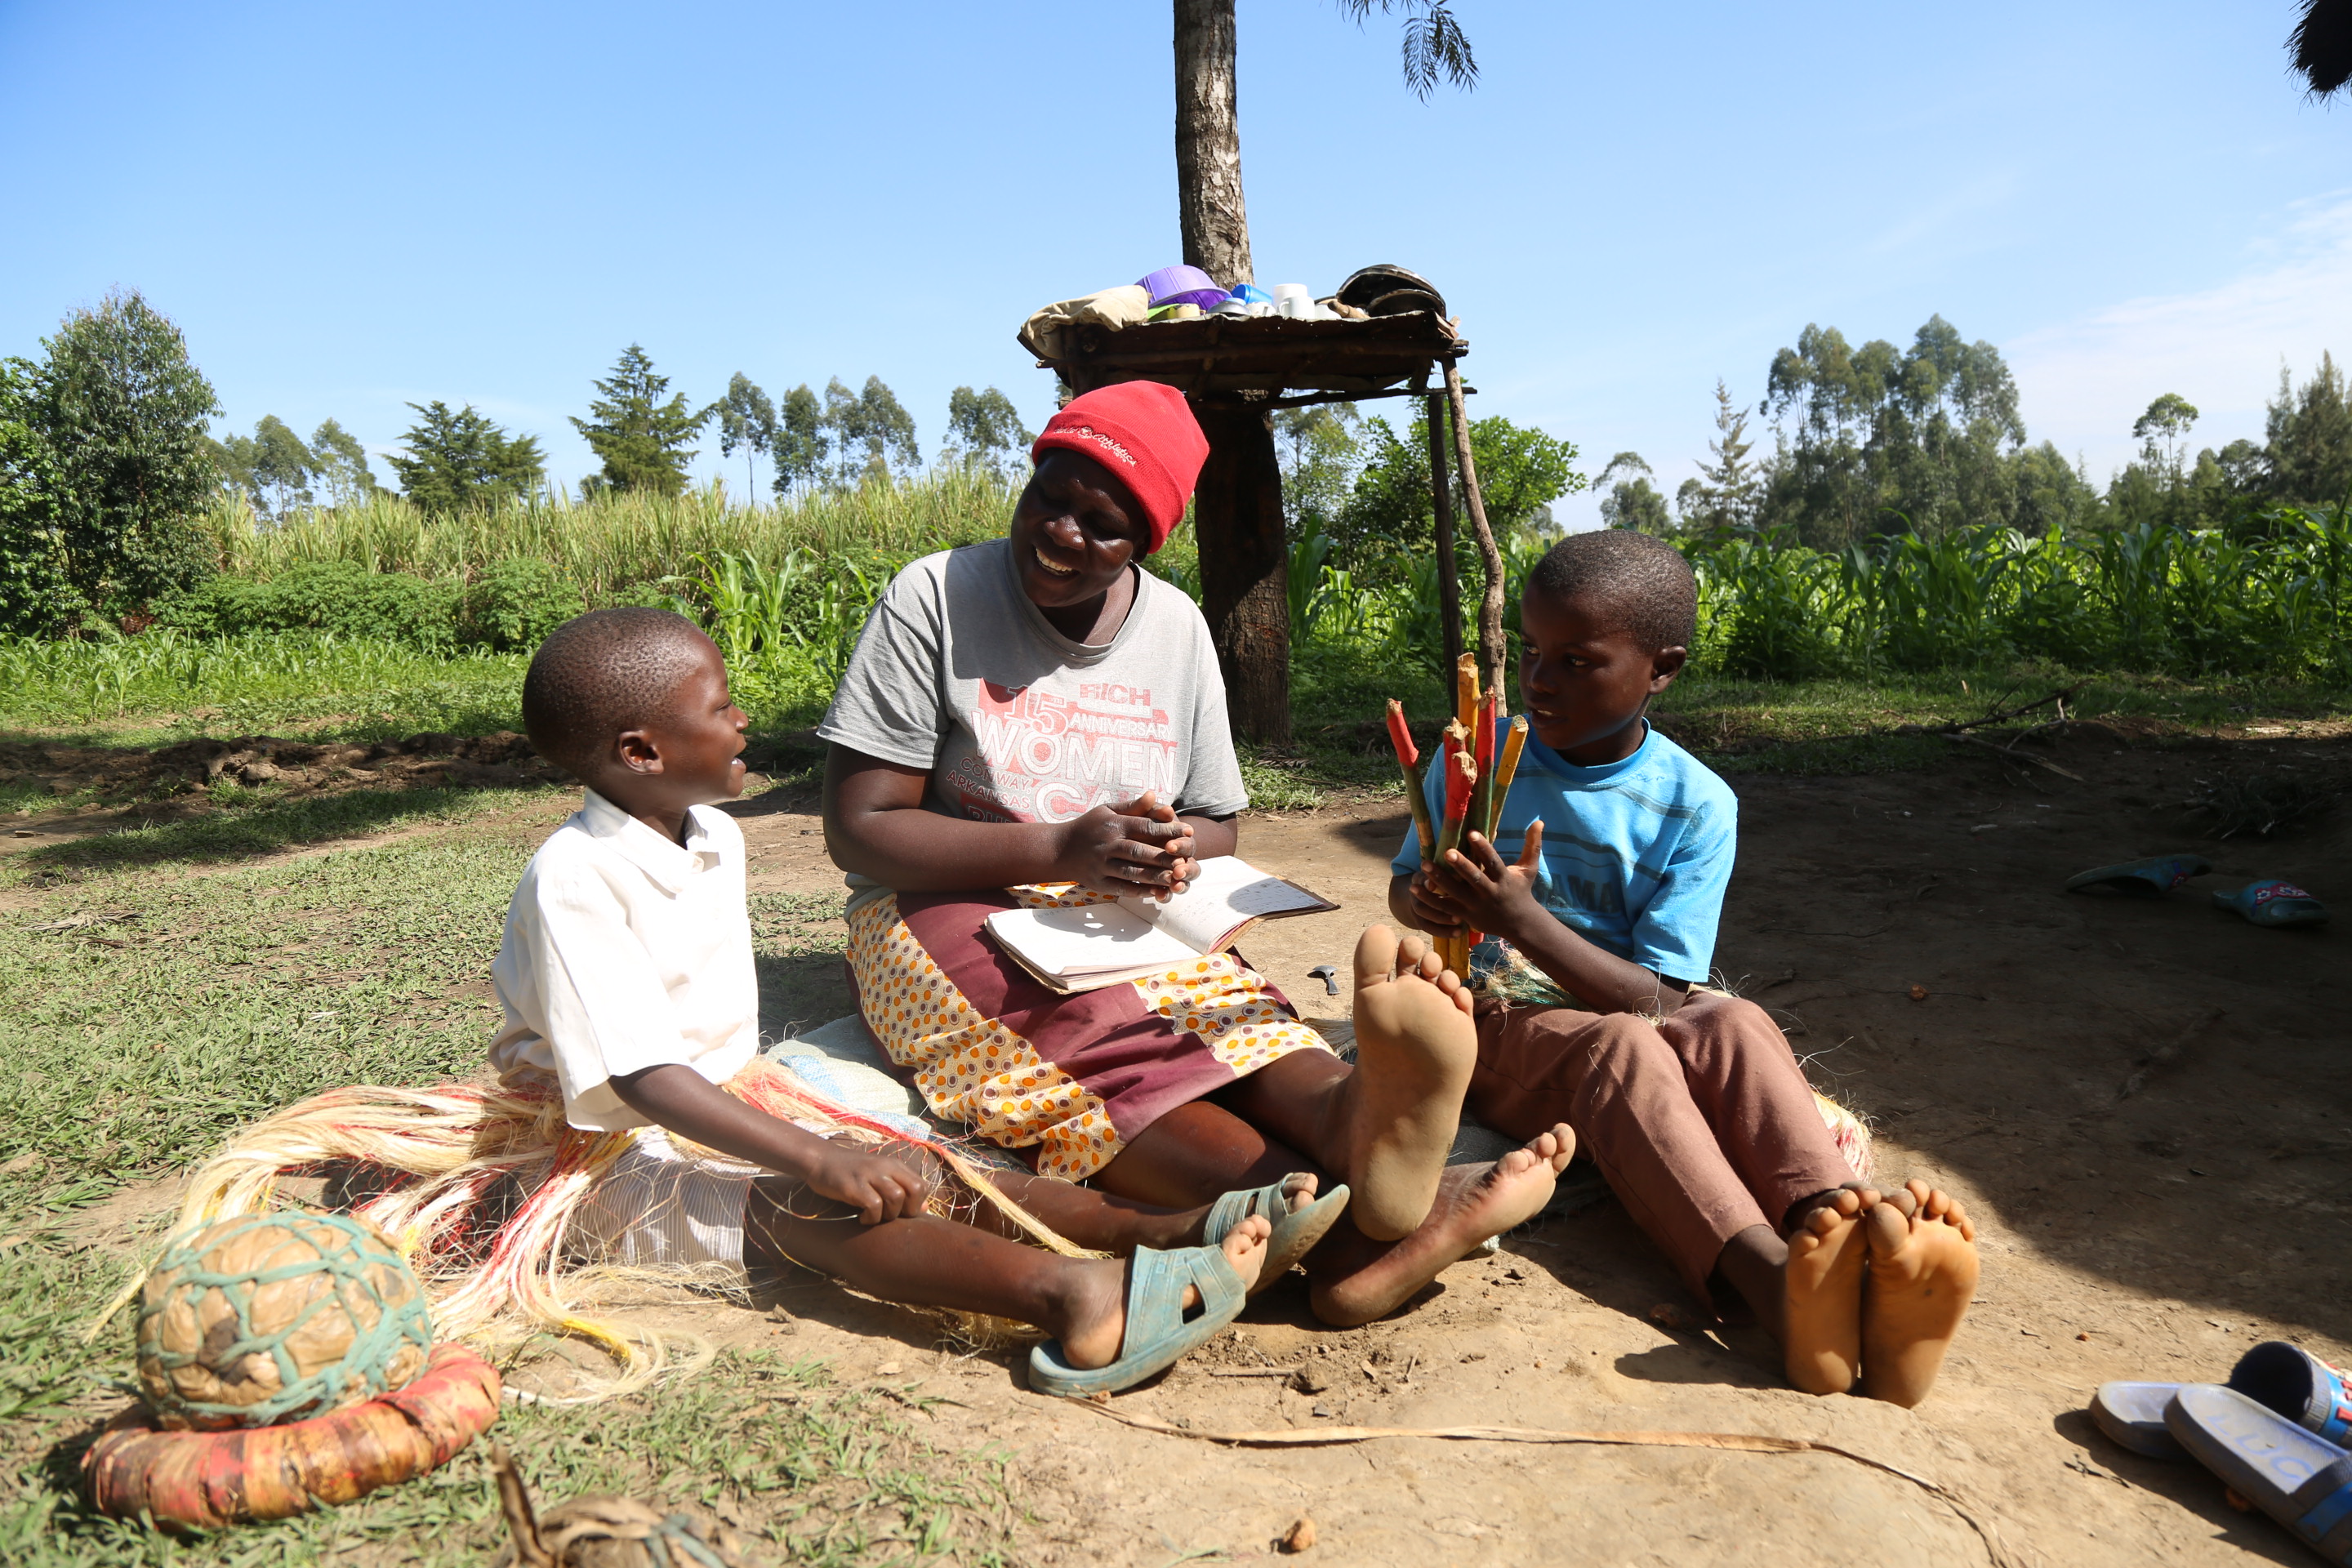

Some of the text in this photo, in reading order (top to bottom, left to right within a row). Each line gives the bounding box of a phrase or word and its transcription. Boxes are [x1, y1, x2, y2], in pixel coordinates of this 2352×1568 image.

[1004, 684, 1069, 737] 15
[1069, 712, 1174, 742] ANNIVERSARY
[960, 756, 1031, 794] CONWAY,
[971, 709, 1177, 795] WOMEN
[946, 770, 1031, 809] ARKANSAS
